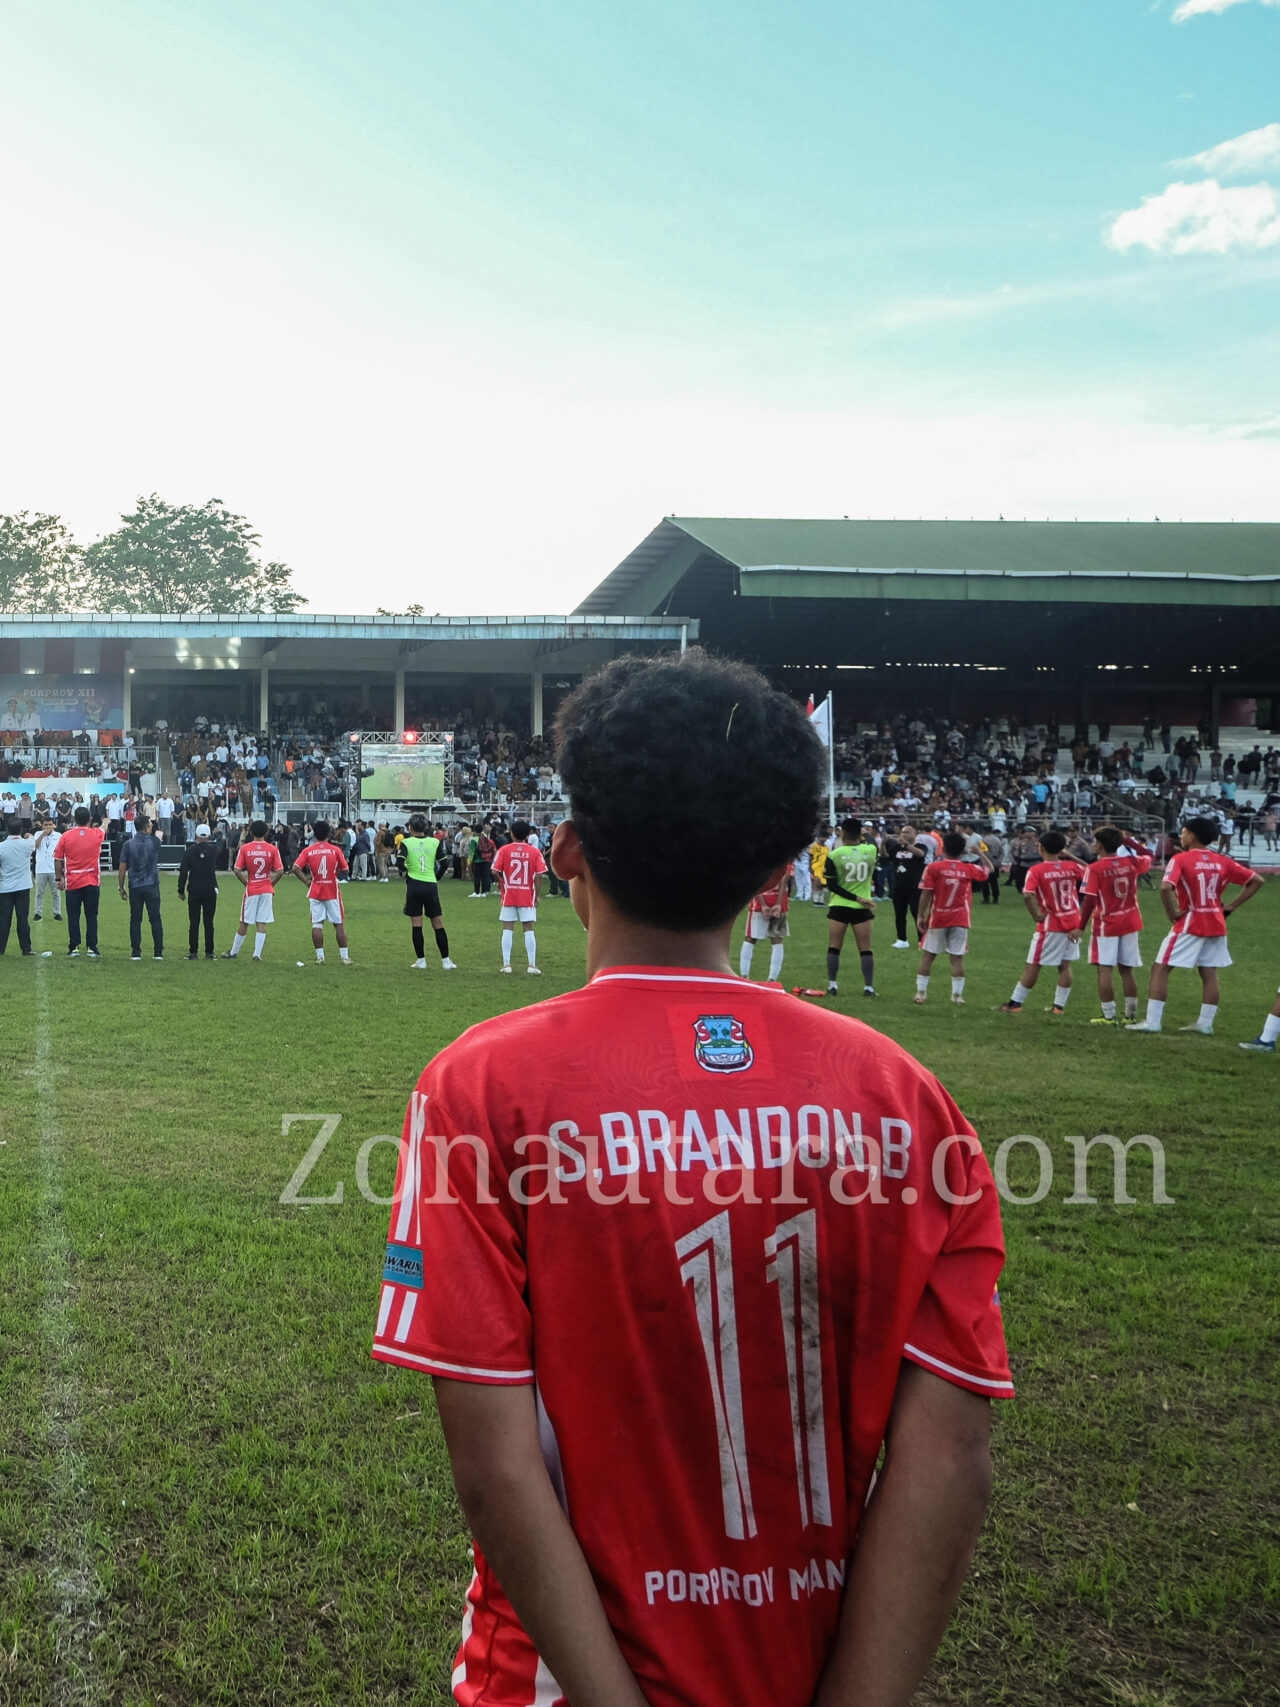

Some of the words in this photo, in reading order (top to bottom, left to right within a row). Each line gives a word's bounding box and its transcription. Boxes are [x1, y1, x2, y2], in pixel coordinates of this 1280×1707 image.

[253, 857, 266, 879] 2
[318, 855, 327, 879] 4
[419, 855, 426, 872] 1
[509, 859, 529, 885] 21
[845, 861, 868, 882] 20
[945, 879, 959, 907] 7
[1050, 880, 1073, 912] 18
[1114, 877, 1129, 908] 9
[1197, 872, 1219, 906] 14
[674, 1208, 833, 1541] 11
[645, 1566, 774, 1608] PORPROV
